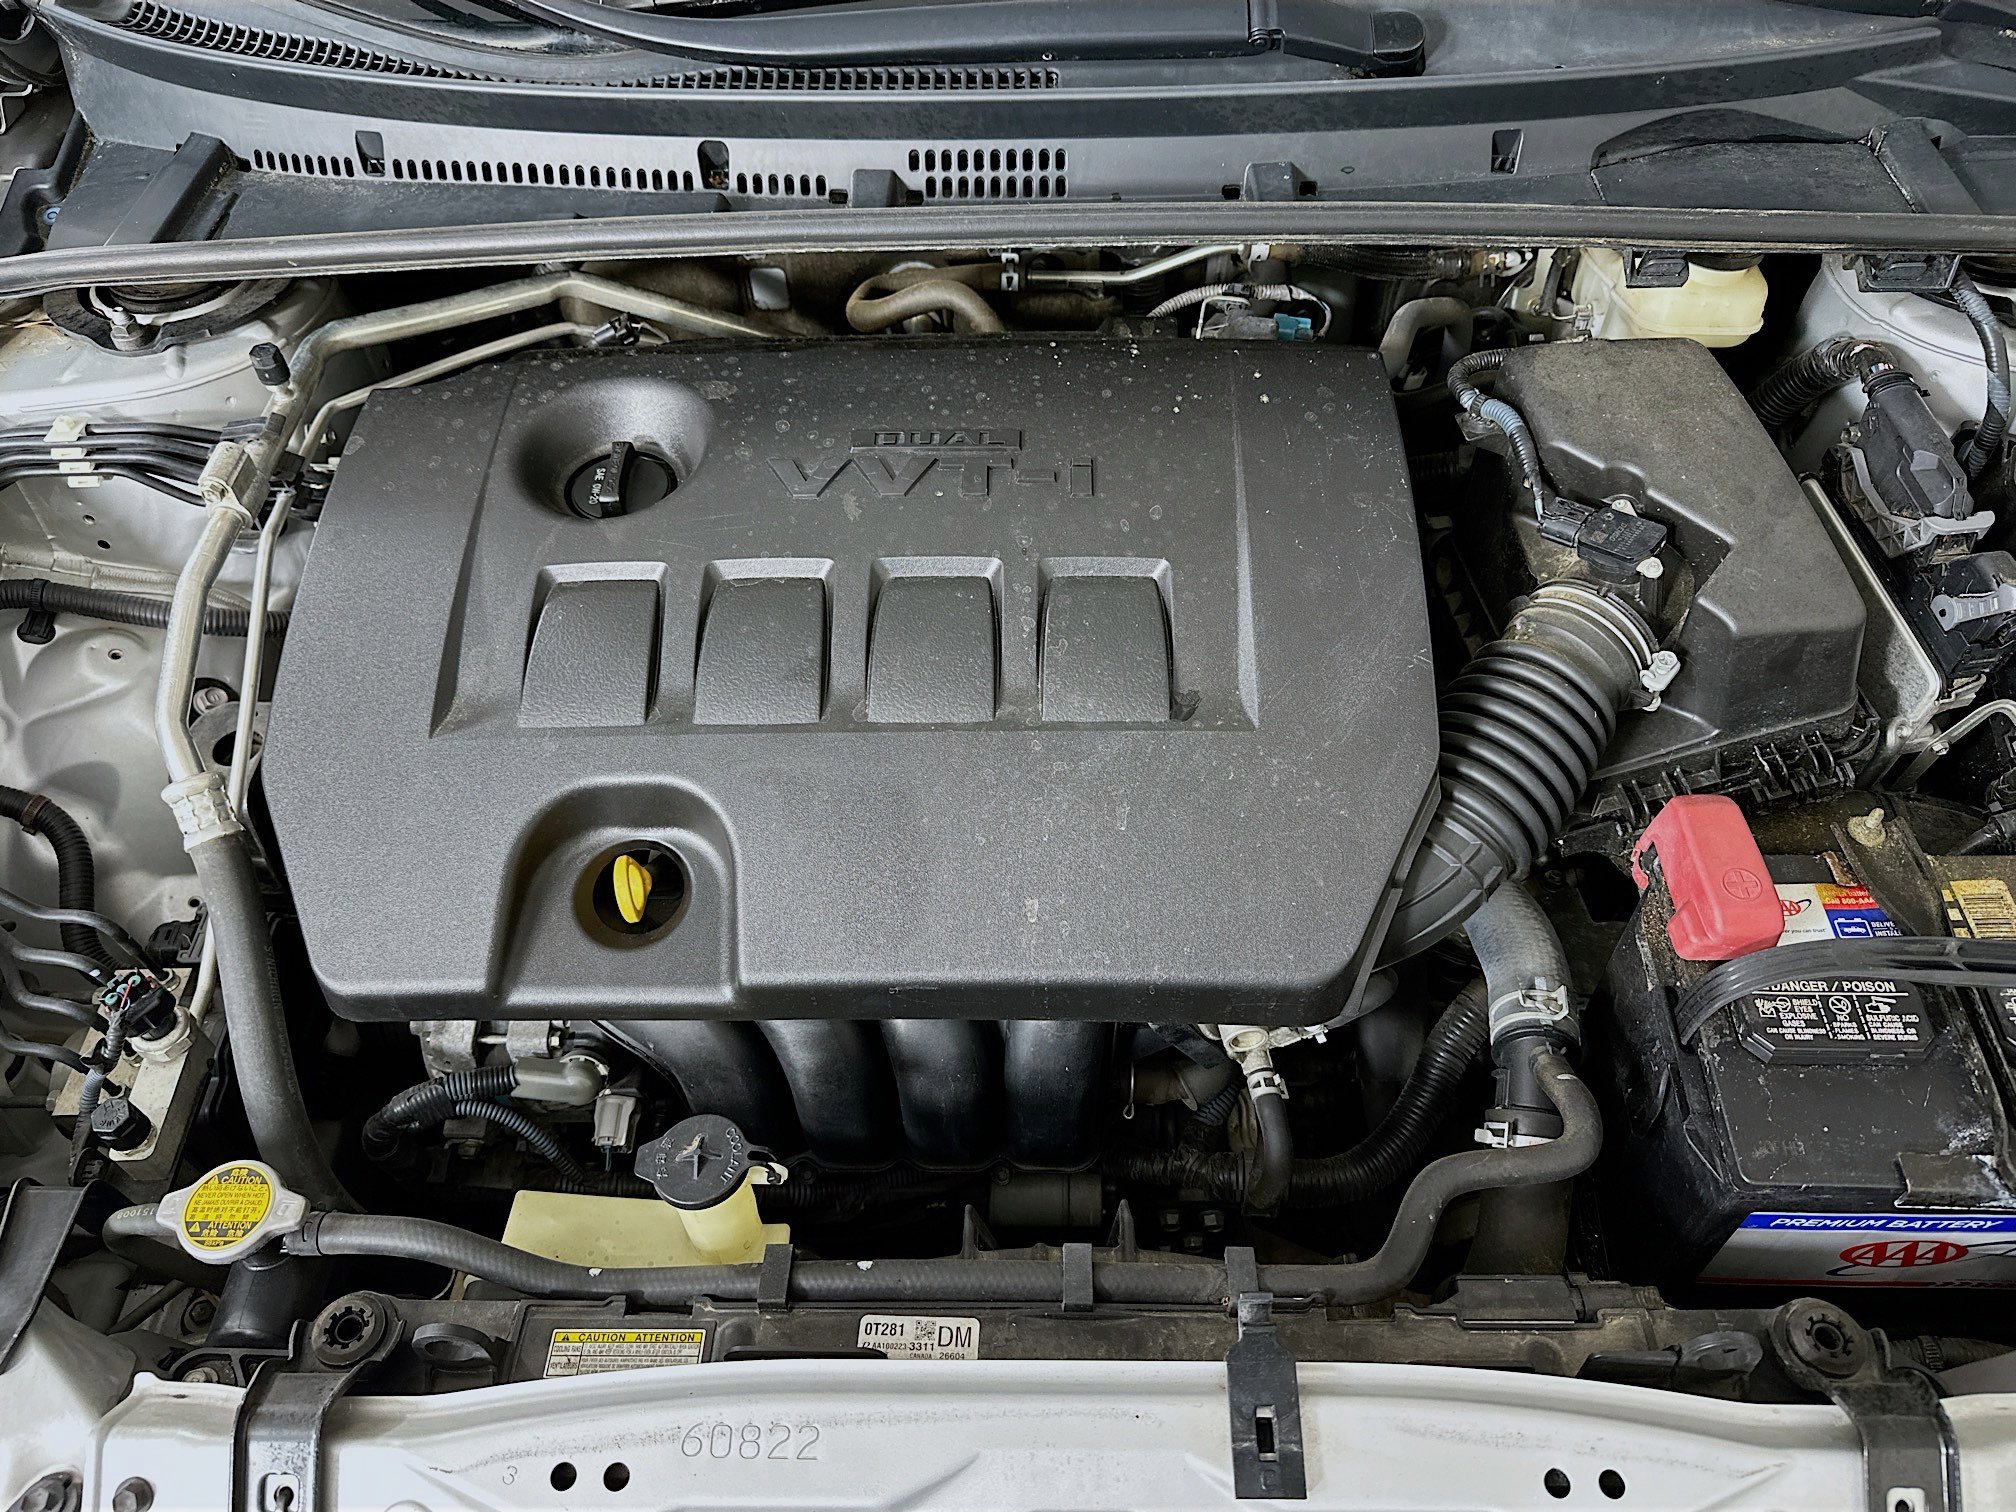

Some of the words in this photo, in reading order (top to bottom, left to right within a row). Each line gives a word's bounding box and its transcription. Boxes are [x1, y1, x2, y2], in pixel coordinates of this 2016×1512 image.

[873, 430, 1005, 446] DUAL
[594, 467, 607, 481] SAE
[766, 456, 1095, 498] VVT-i
[1825, 897, 1840, 905] Call
[1770, 981, 1829, 992] DANGER
[1842, 981, 1897, 993] POISON
[1792, 999, 1818, 1007] SHIELD
[1779, 1013, 1819, 1021] EXPLOSIVE
[1836, 1014, 1850, 1022] NO
[1865, 1014, 1901, 1023] SULFURIC
[720, 1127, 744, 1186] COOLANT
[221, 1175, 263, 1184] CAUTION
[117, 1207, 155, 1220] 151008
[207, 1221, 252, 1229] ATTENTION
[1769, 1218, 1887, 1228] PREMIUM
[1886, 1219, 2004, 1230] BATTERY
[1846, 1241, 1958, 1268] AAA
[578, 1333, 627, 1342] CAUTION
[634, 1333, 696, 1342] ATTENTION
[937, 1325, 973, 1348] DM
[909, 1352, 933, 1360] CANADA
[680, 1421, 821, 1461] 60822
